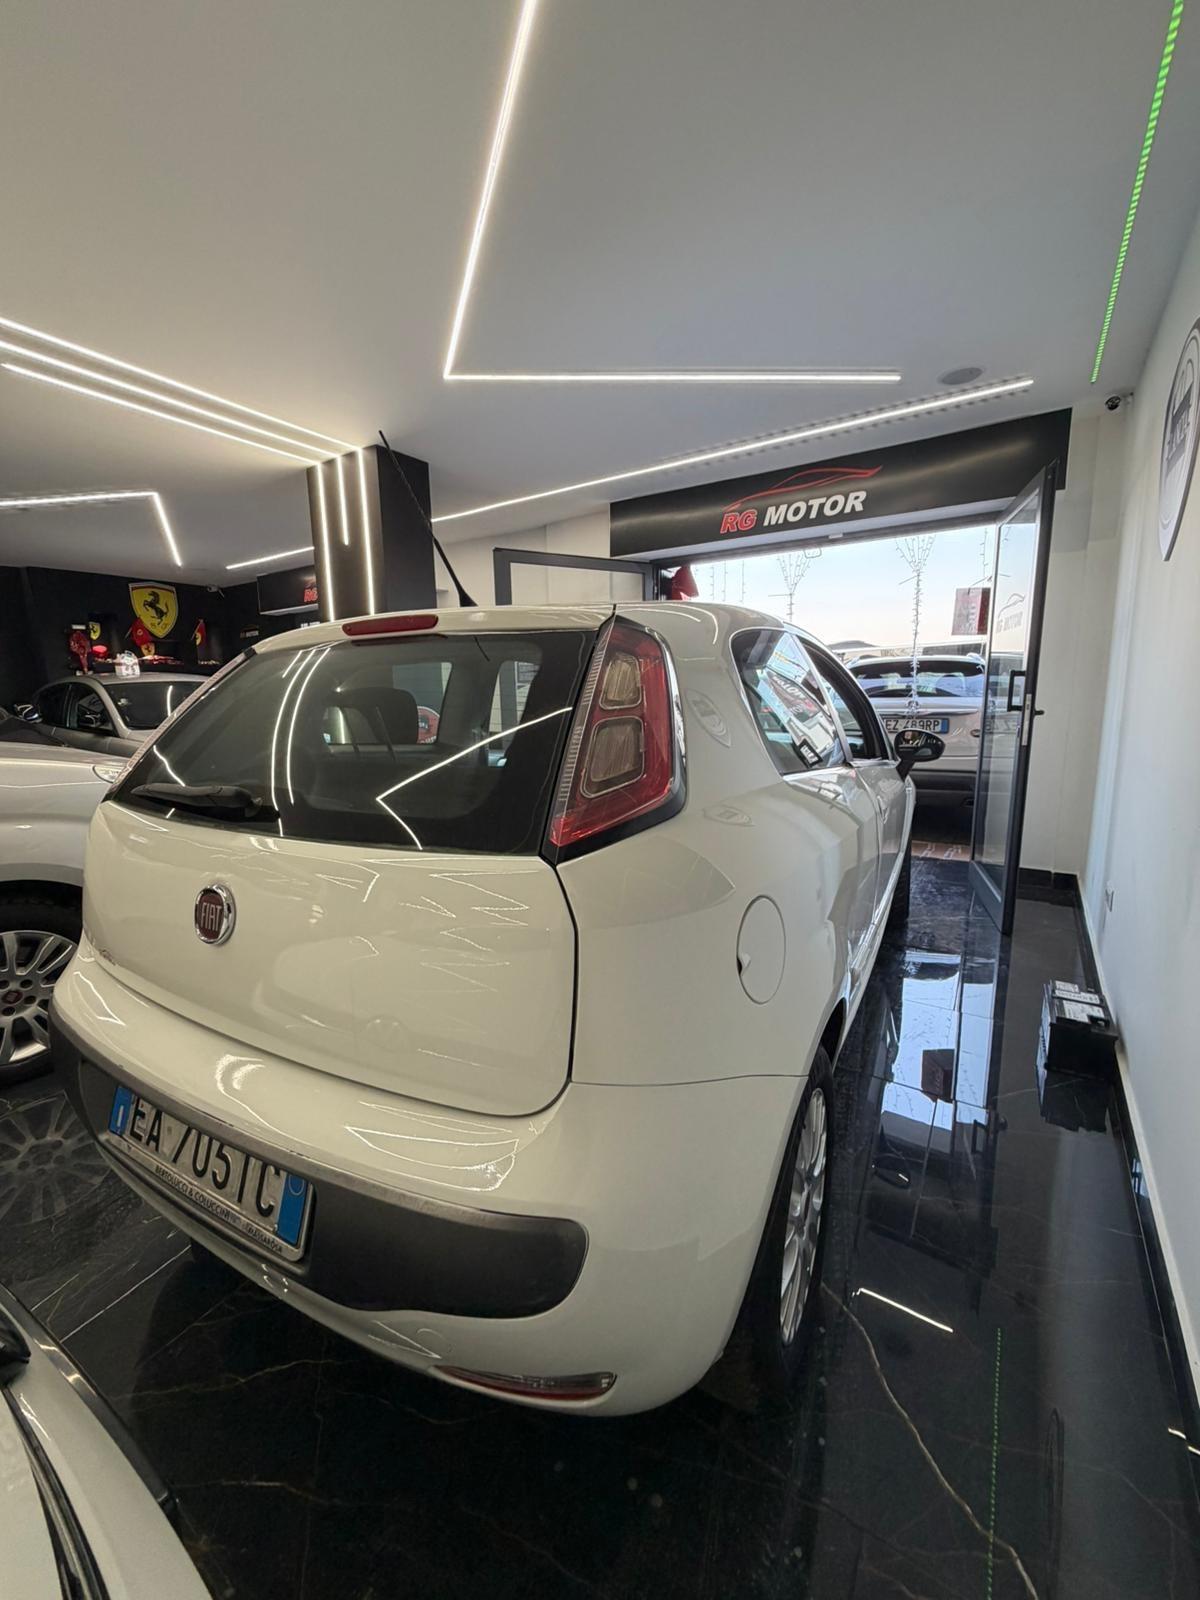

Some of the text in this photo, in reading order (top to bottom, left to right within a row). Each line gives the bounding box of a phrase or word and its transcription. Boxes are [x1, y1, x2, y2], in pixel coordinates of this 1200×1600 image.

[719, 490, 867, 534] RG MOTOR
[885, 719, 899, 732] EZ
[200, 902, 222, 931] FIAT
[129, 1097, 164, 1152] EA
[154, 1164, 188, 1193] BERTOLUCCI
